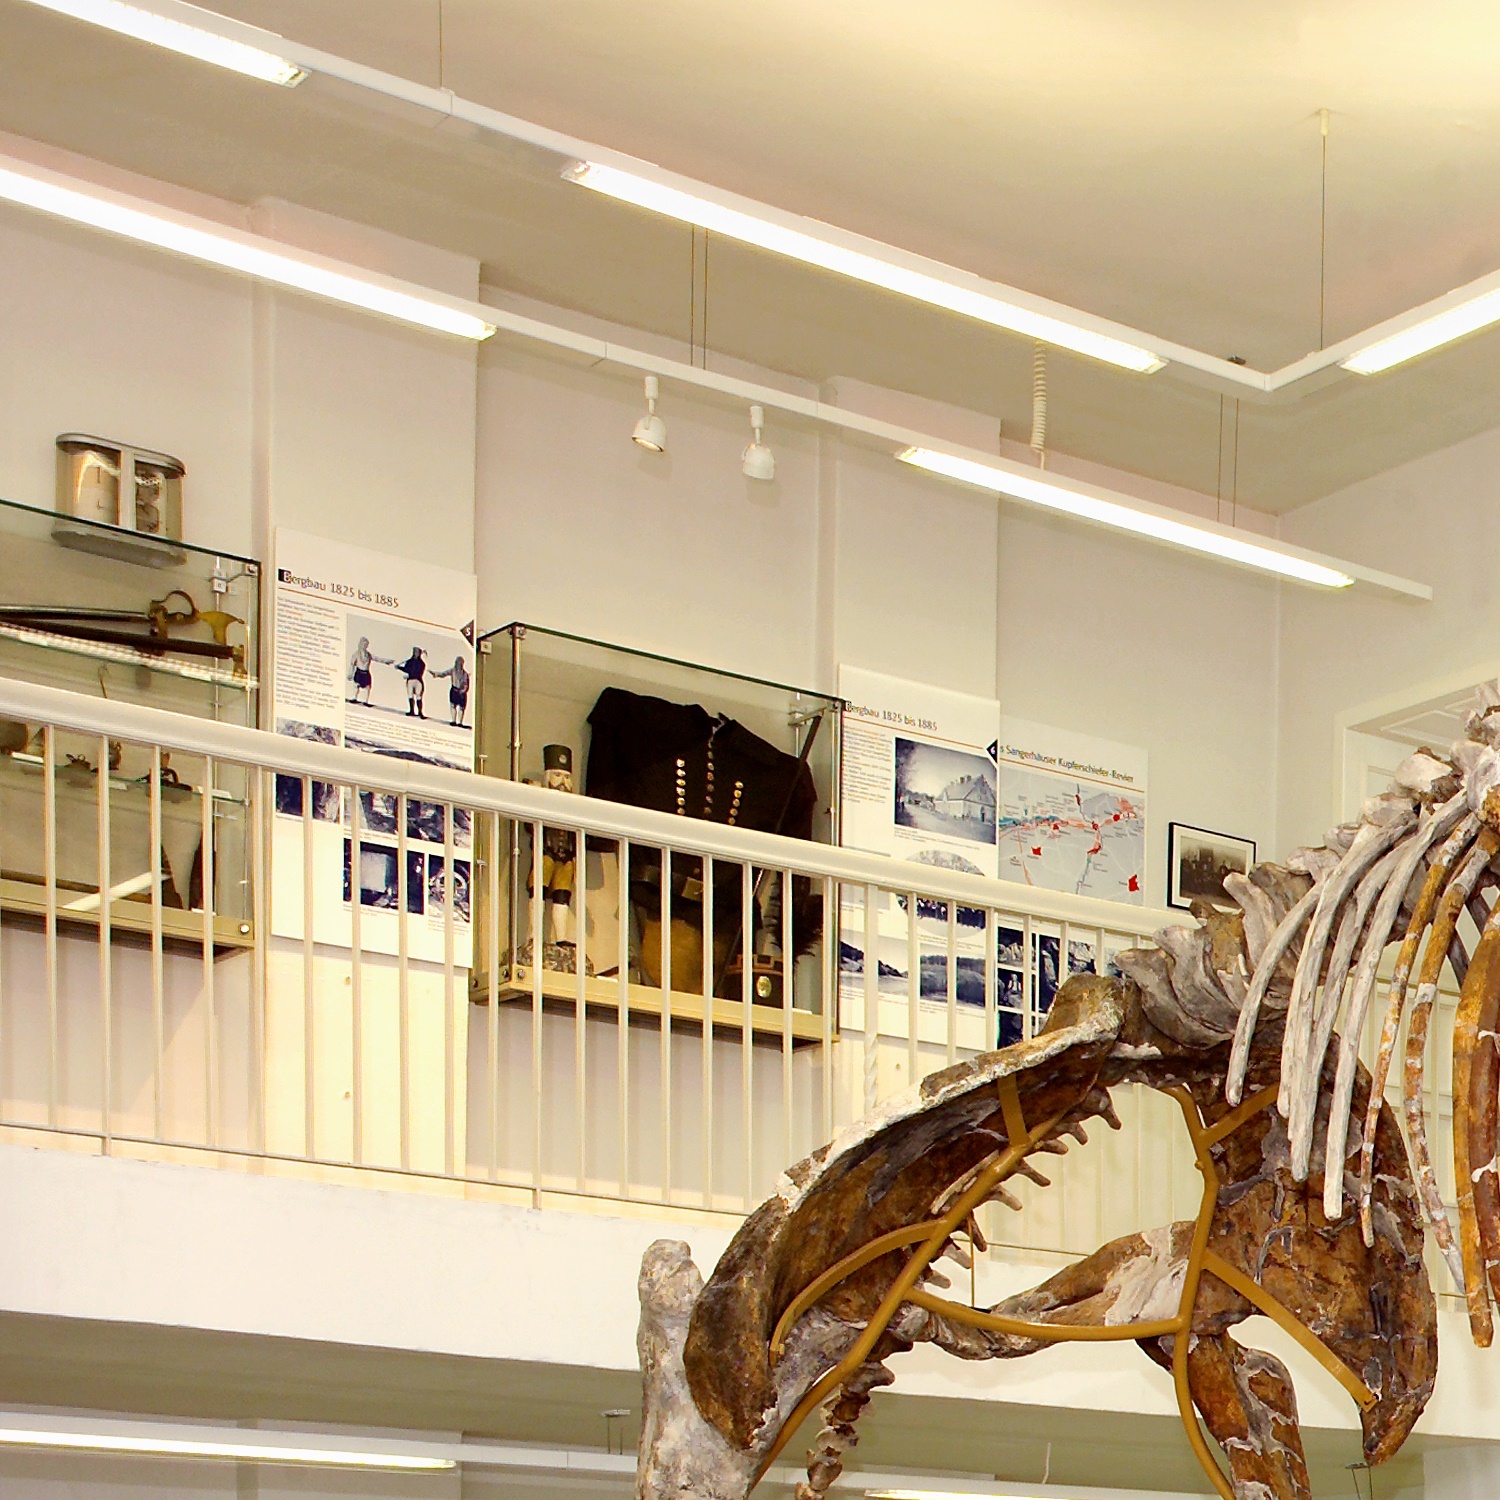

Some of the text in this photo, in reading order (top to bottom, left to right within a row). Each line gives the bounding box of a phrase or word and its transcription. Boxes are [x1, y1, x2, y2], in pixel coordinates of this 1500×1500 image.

[283, 571, 399, 609] Bergbau 1825 bis 1885
[847, 701, 938, 731] Bergbau 1825 bis 1885
